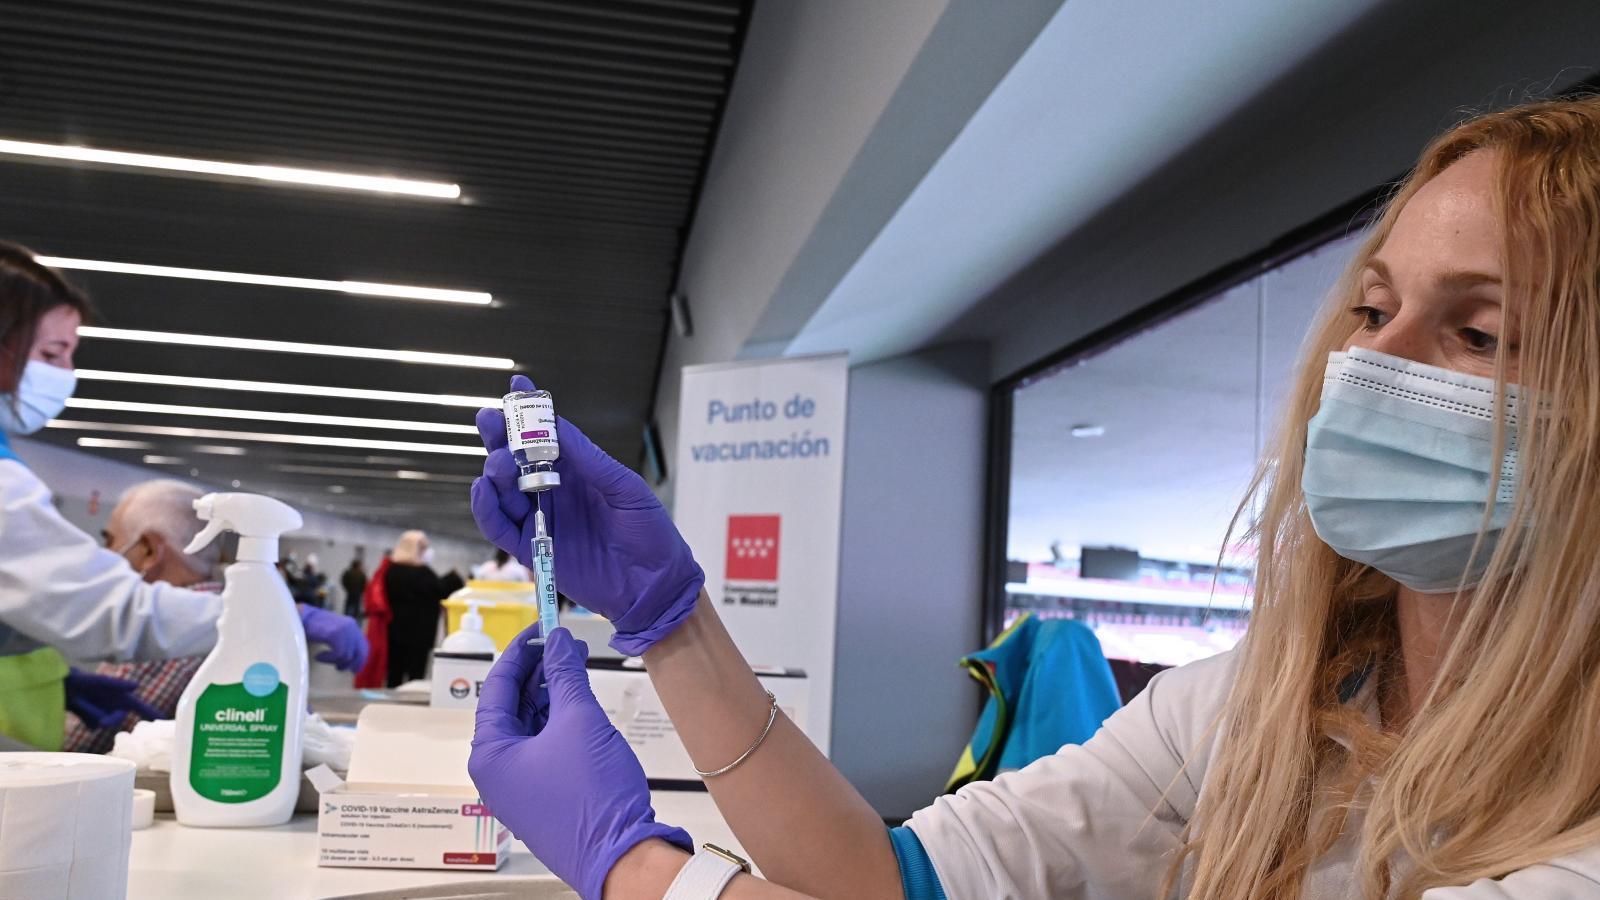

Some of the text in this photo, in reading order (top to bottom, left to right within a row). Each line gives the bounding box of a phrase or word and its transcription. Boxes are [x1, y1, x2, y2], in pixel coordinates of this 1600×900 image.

[707, 394, 815, 424] Punto de
[691, 430, 830, 462] vacunación
[215, 708, 265, 722] clinell
[200, 723, 278, 732] UNIVERSAL SPRAY
[341, 804, 378, 813] COVID-19
[380, 805, 409, 814] Vaccine
[411, 805, 459, 815] AstraZeneca
[465, 805, 471, 815] 5
